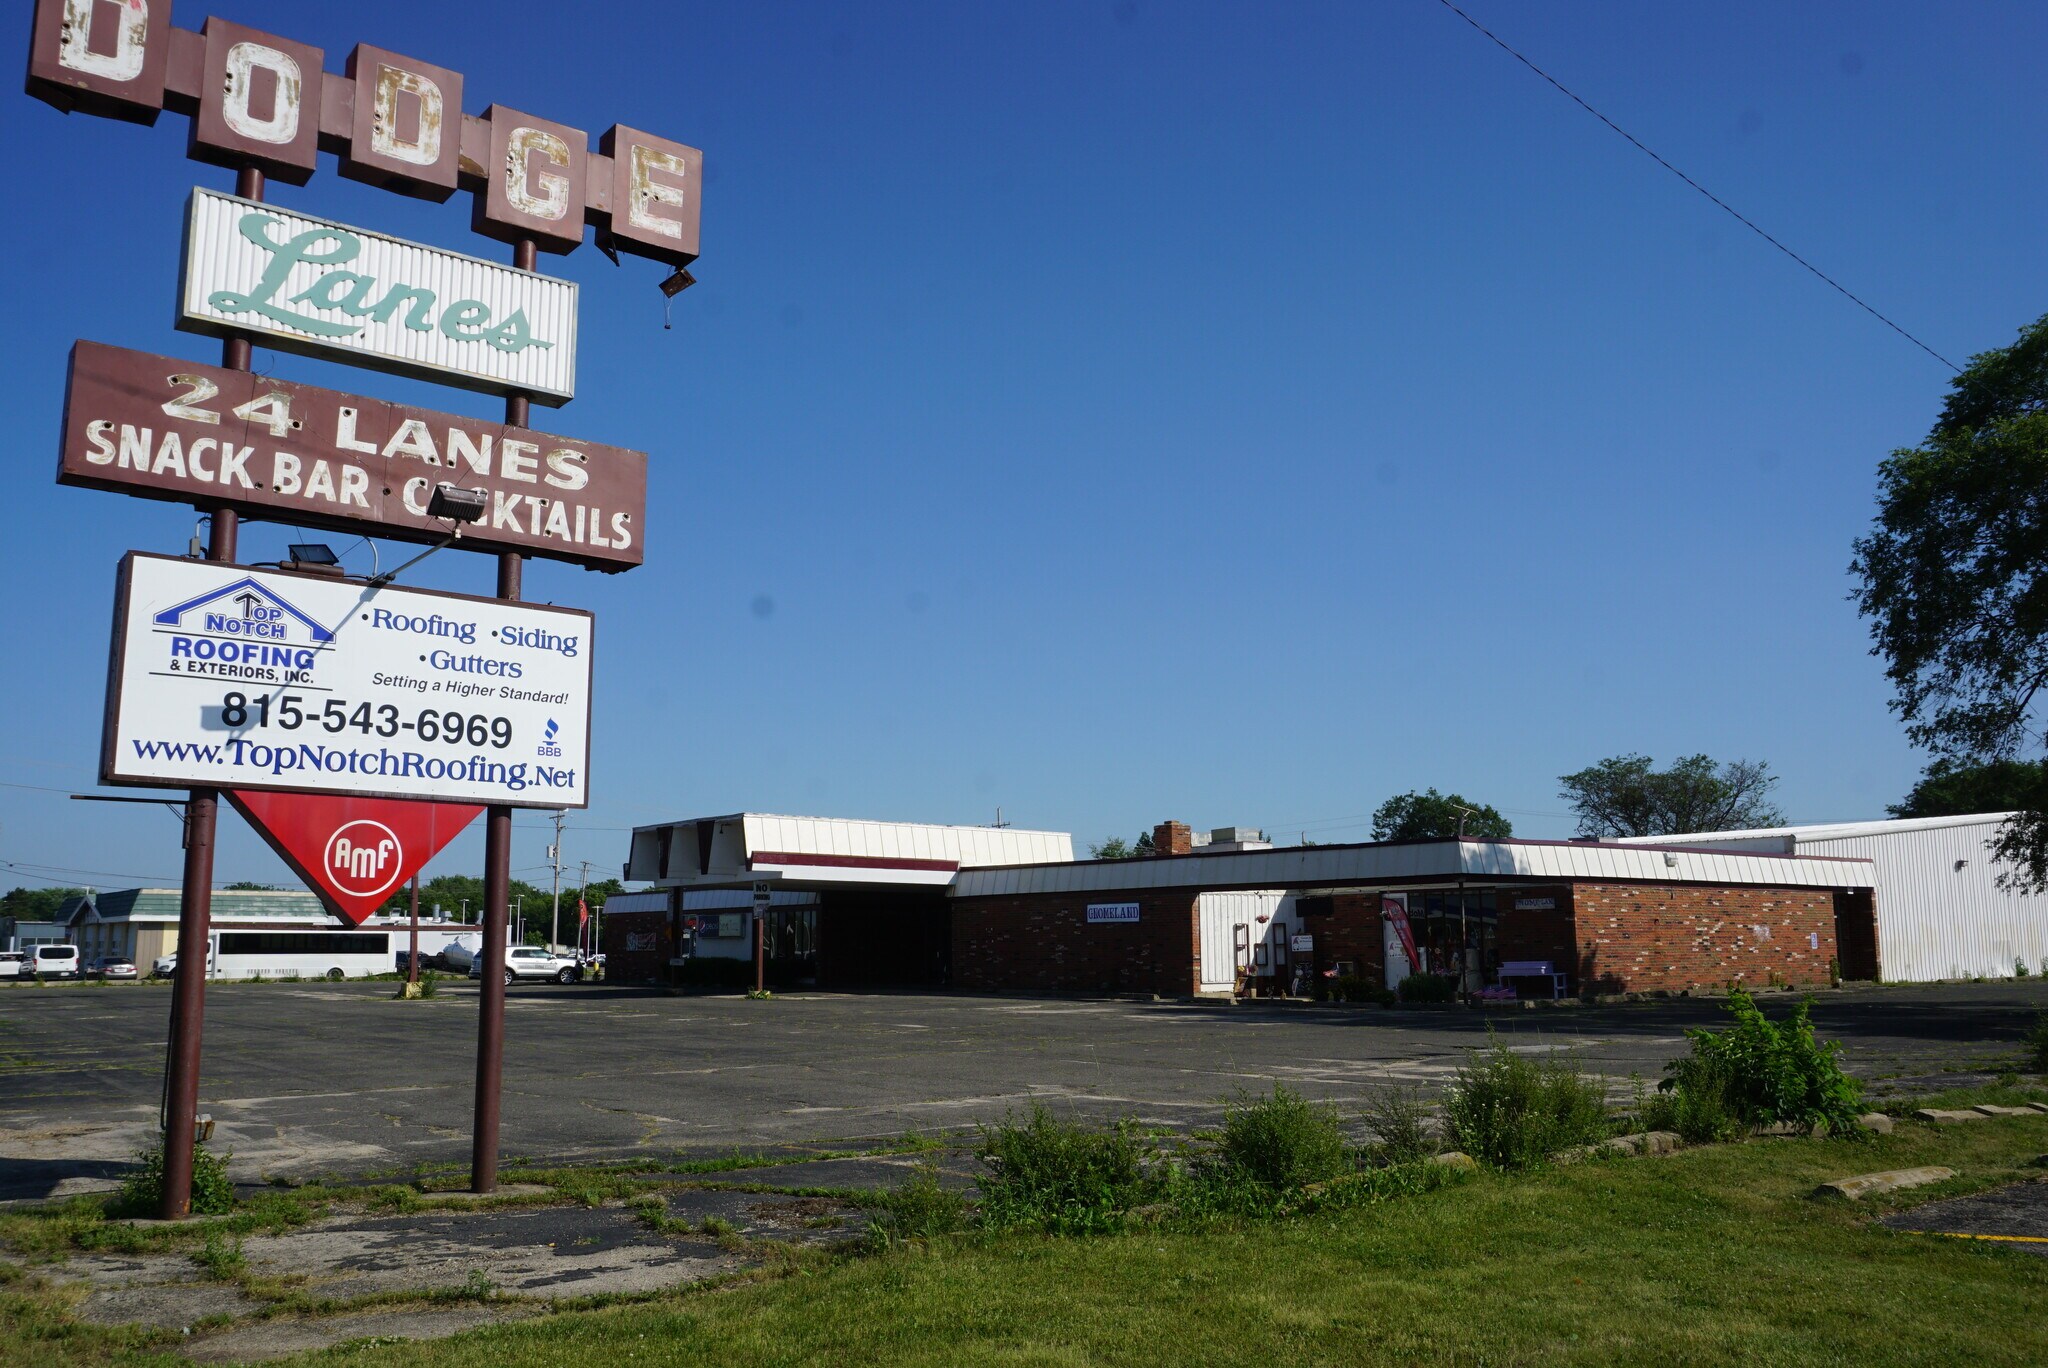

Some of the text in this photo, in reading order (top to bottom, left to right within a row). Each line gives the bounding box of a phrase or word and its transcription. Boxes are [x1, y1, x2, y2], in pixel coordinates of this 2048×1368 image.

[59, 0, 686, 240] DODGE
[208, 213, 555, 353] Lanes
[161, 374, 590, 490] 24 LANES
[86, 419, 632, 550] SNACK BAR CKTAILS
[205, 613, 286, 639] NOTCH
[372, 608, 579, 658] Roofing Siding
[170, 659, 314, 684] & EXTERIORS, INC.
[171, 636, 315, 670] ROOFING
[430, 650, 523, 679] Gutters
[372, 672, 569, 705] Setting a Higher Standard!
[221, 691, 513, 749] 815-543-6969
[132, 737, 576, 791] www.TopNotchRoofing.Net
[537, 746, 562, 757] BBB
[756, 884, 768, 892] NO
